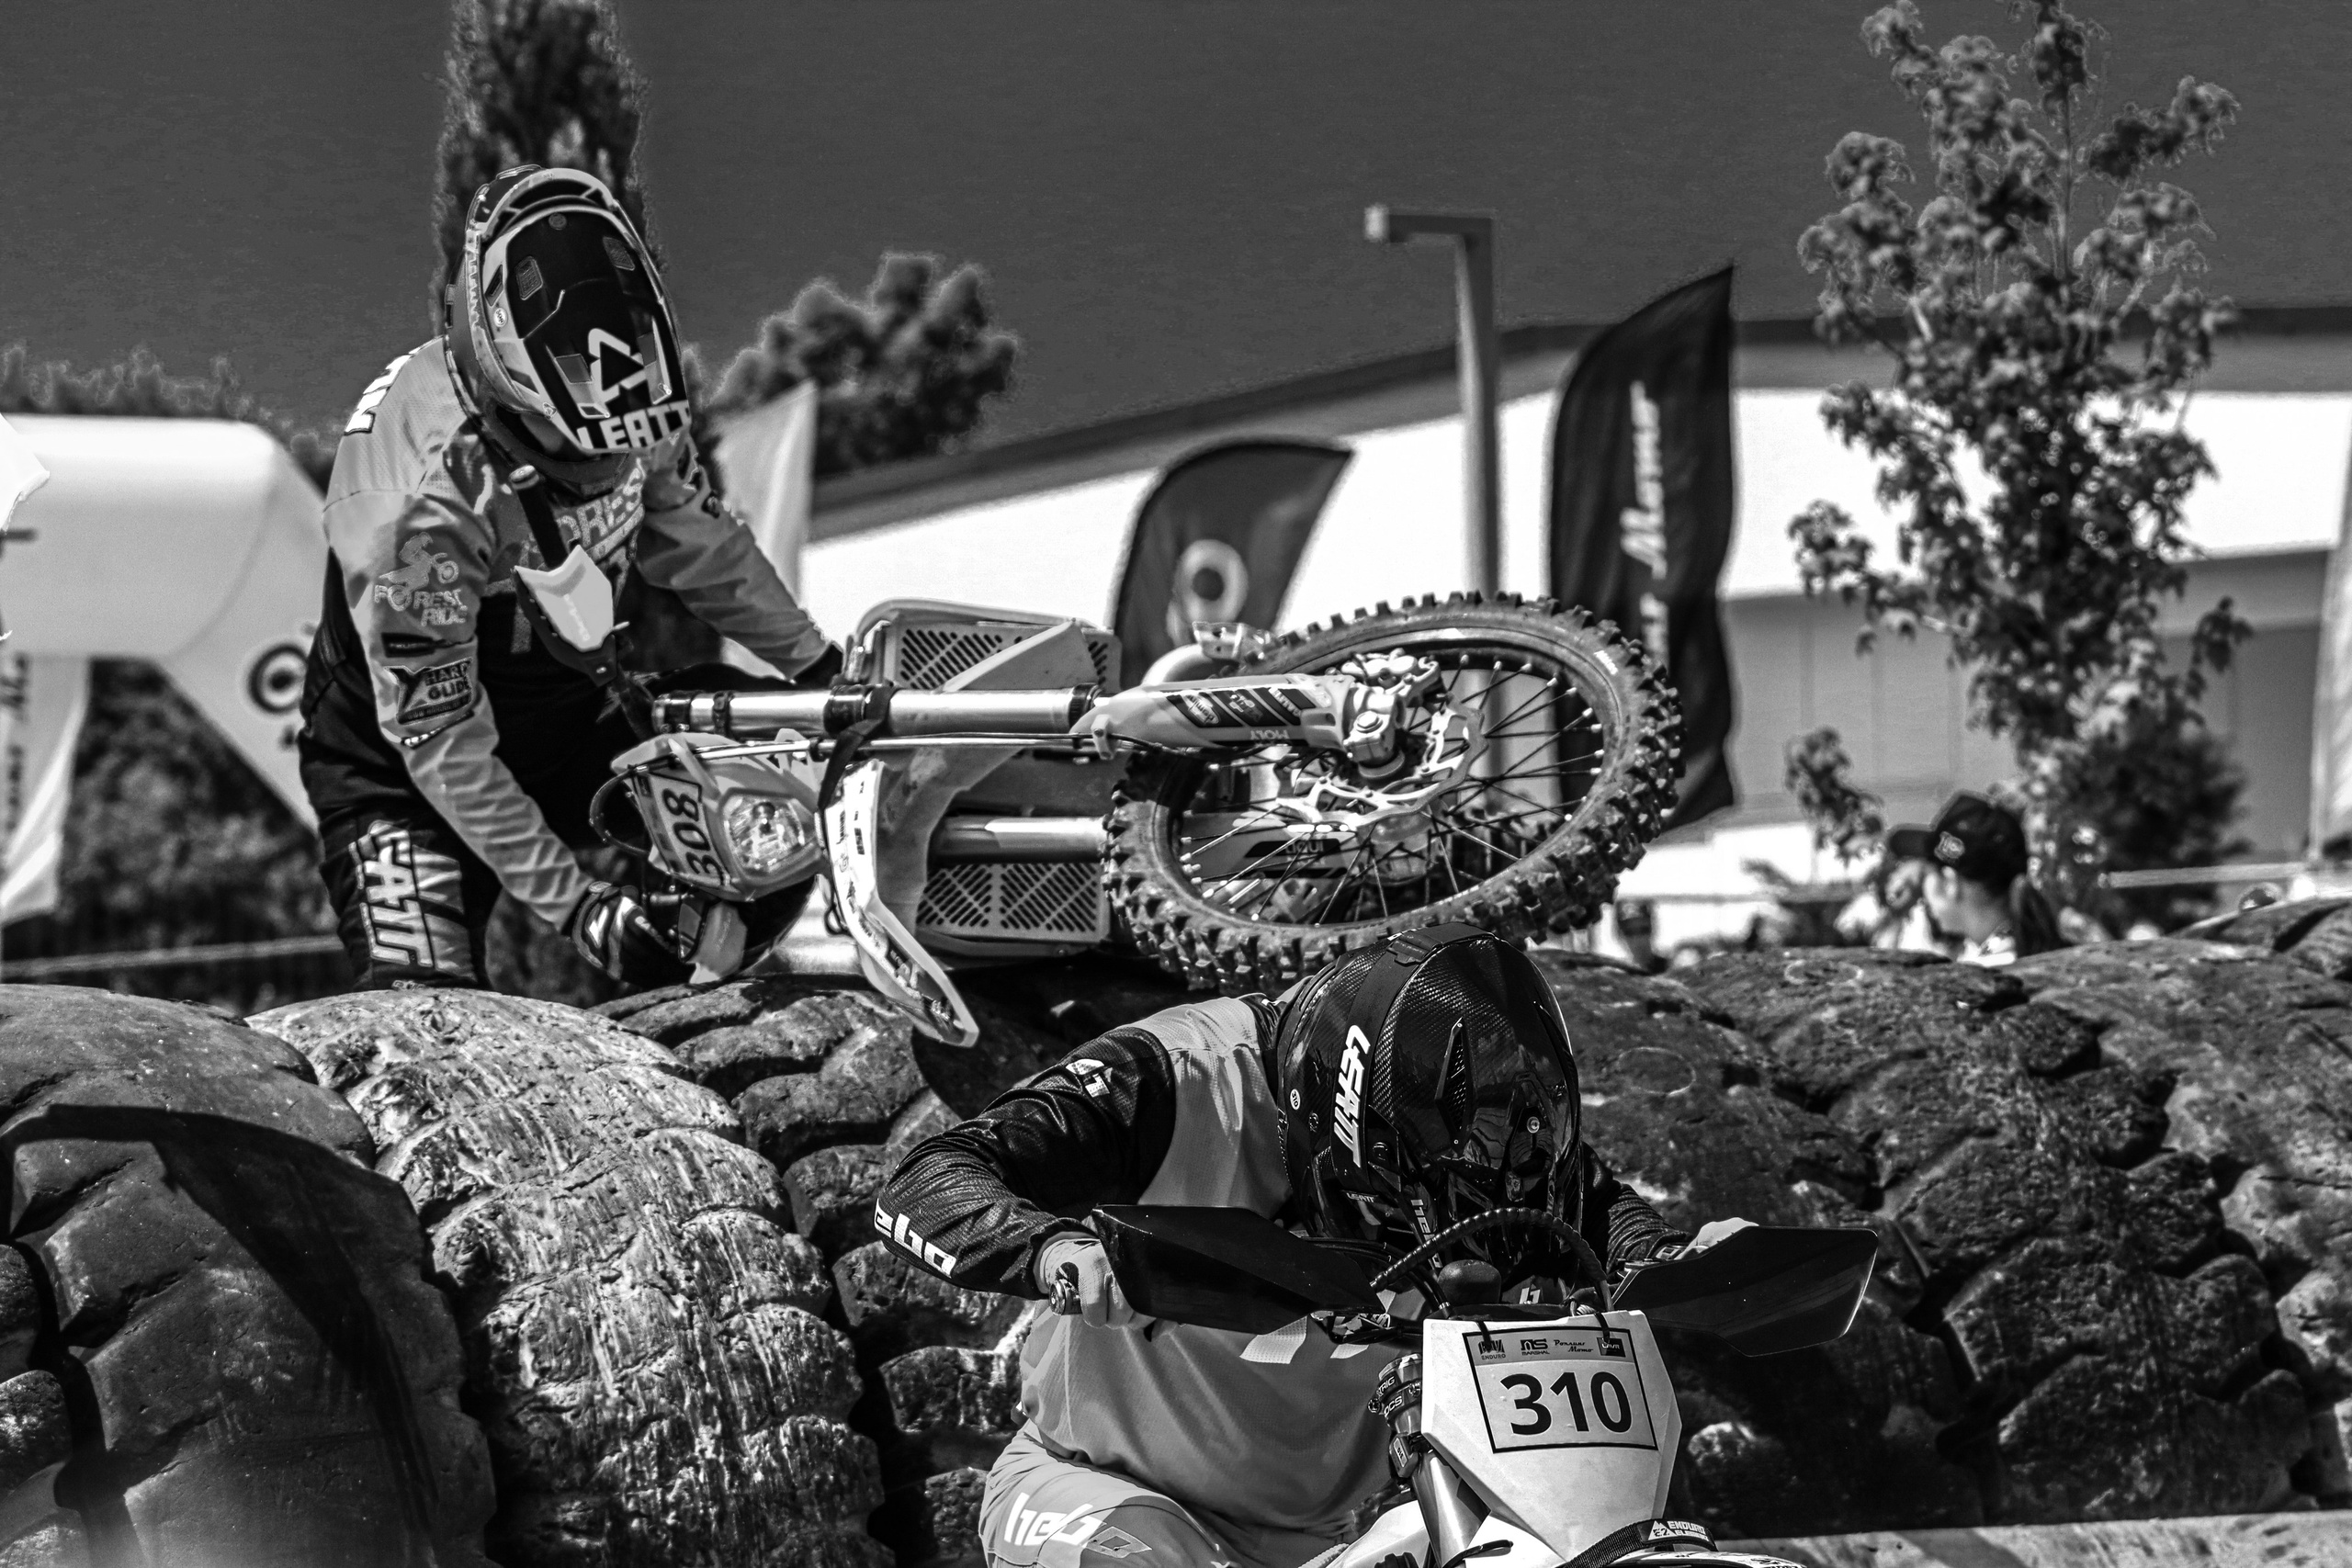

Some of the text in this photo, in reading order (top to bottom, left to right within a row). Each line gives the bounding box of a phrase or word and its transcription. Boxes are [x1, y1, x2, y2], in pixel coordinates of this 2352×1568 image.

[662, 788, 724, 886] 308
[1333, 1024, 1372, 1168] LEATT
[1481, 1353, 1507, 1361] ENDURO
[1384, 1395, 1403, 1417] OCS
[1499, 1371, 1633, 1436] 310
